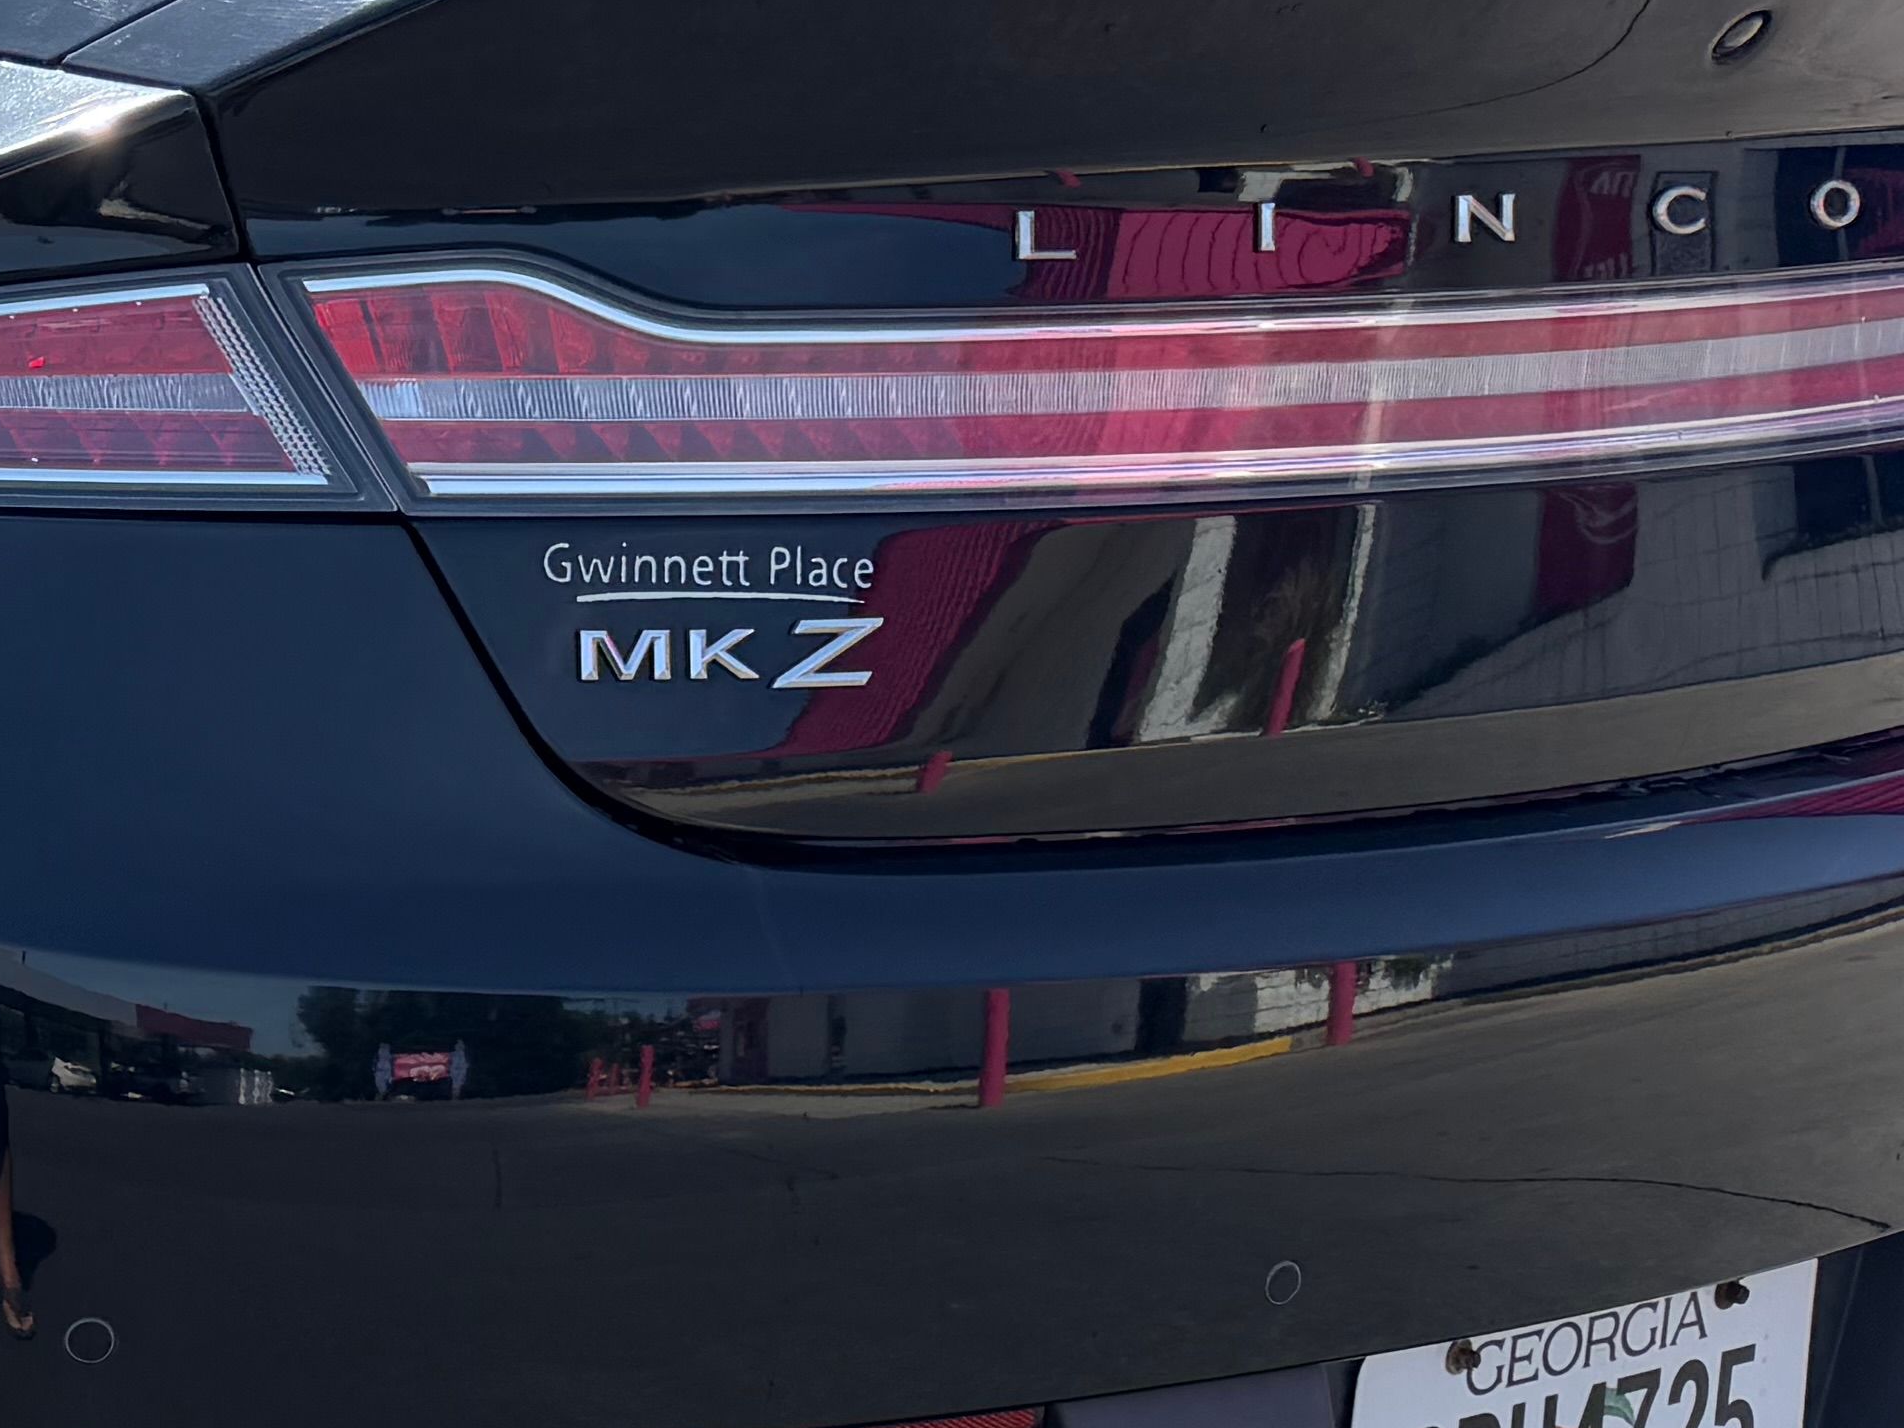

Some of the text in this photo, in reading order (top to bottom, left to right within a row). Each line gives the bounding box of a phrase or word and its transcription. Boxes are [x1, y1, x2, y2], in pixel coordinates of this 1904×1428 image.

[543, 542, 875, 589] Gwinnett Place
[579, 617, 884, 689] MKZ
[1466, 1292, 1707, 1396] GEORGIA
